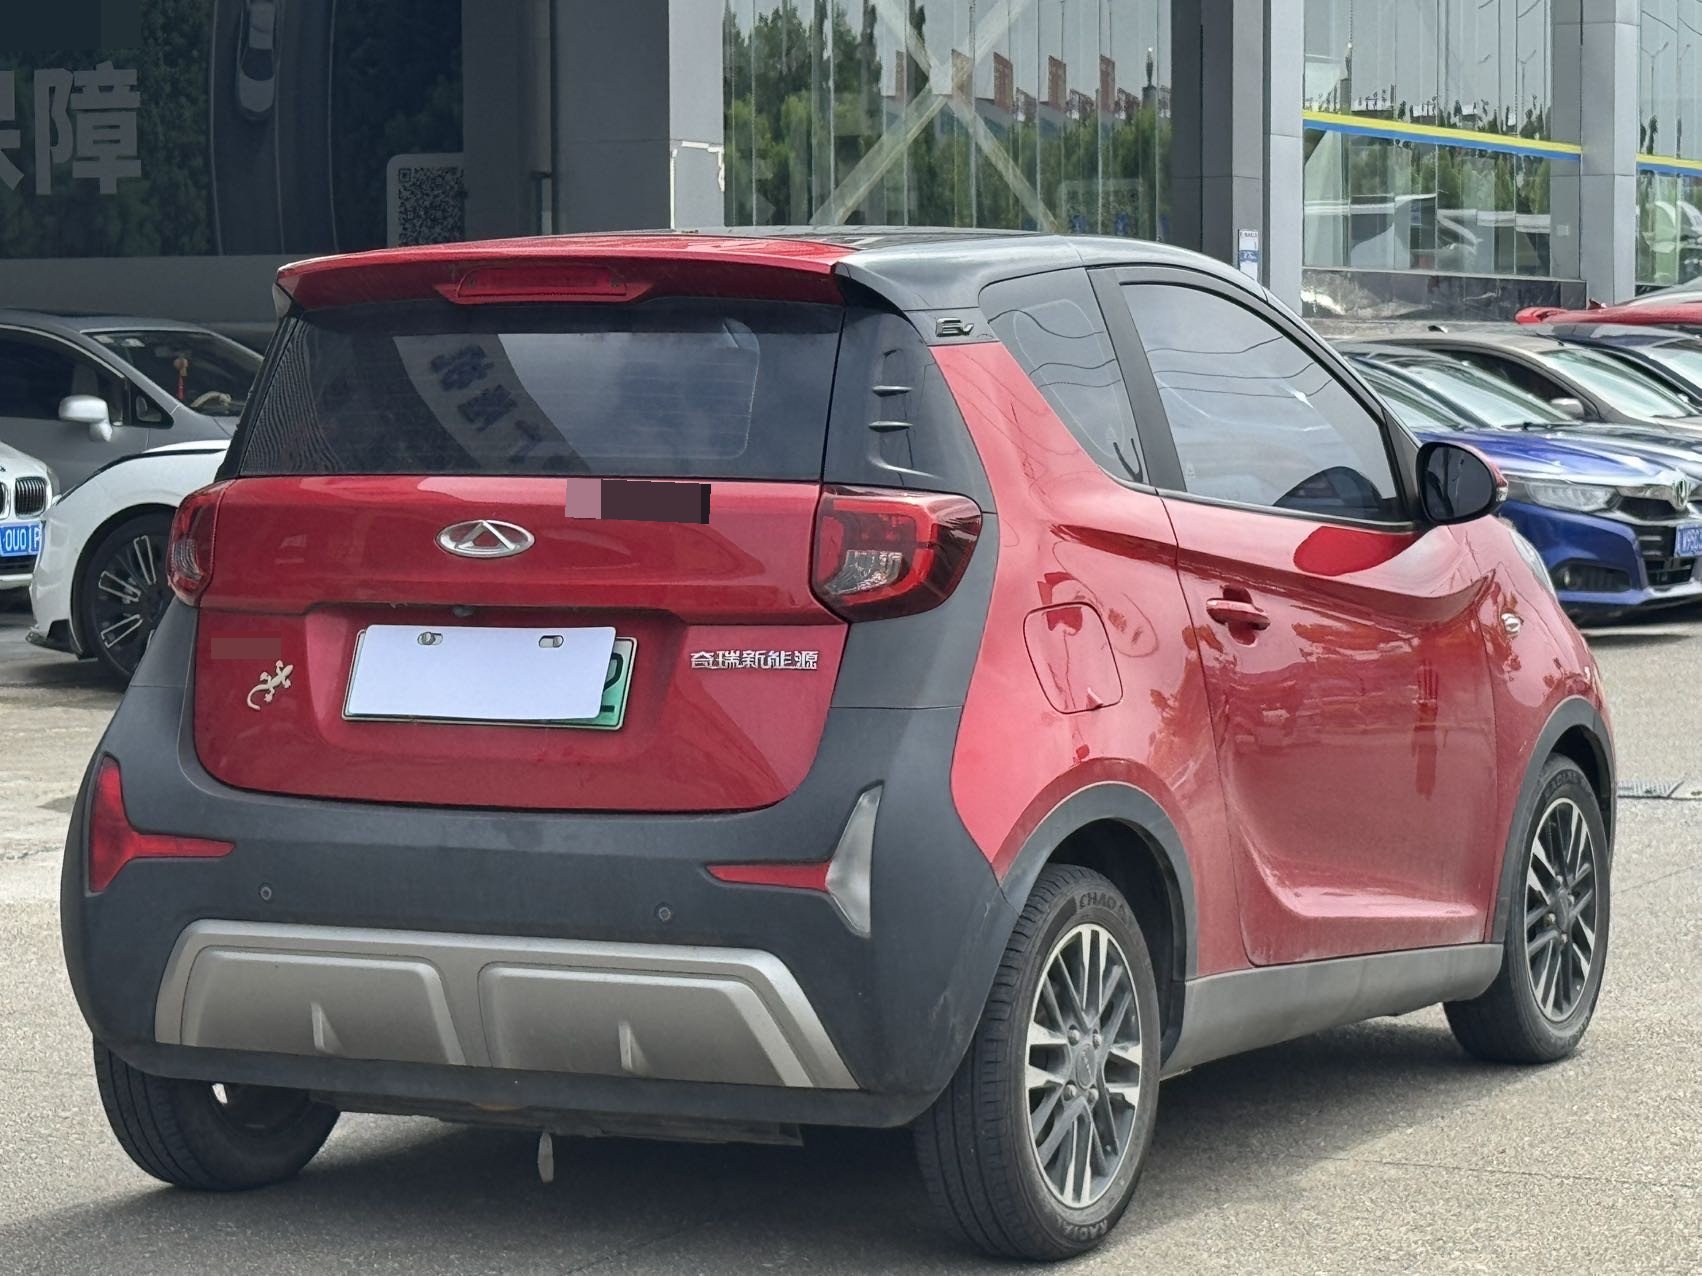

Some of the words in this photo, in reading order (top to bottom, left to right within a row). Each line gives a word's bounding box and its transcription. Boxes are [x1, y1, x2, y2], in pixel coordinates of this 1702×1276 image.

[690, 650, 819, 671] 奇瑞新能源
